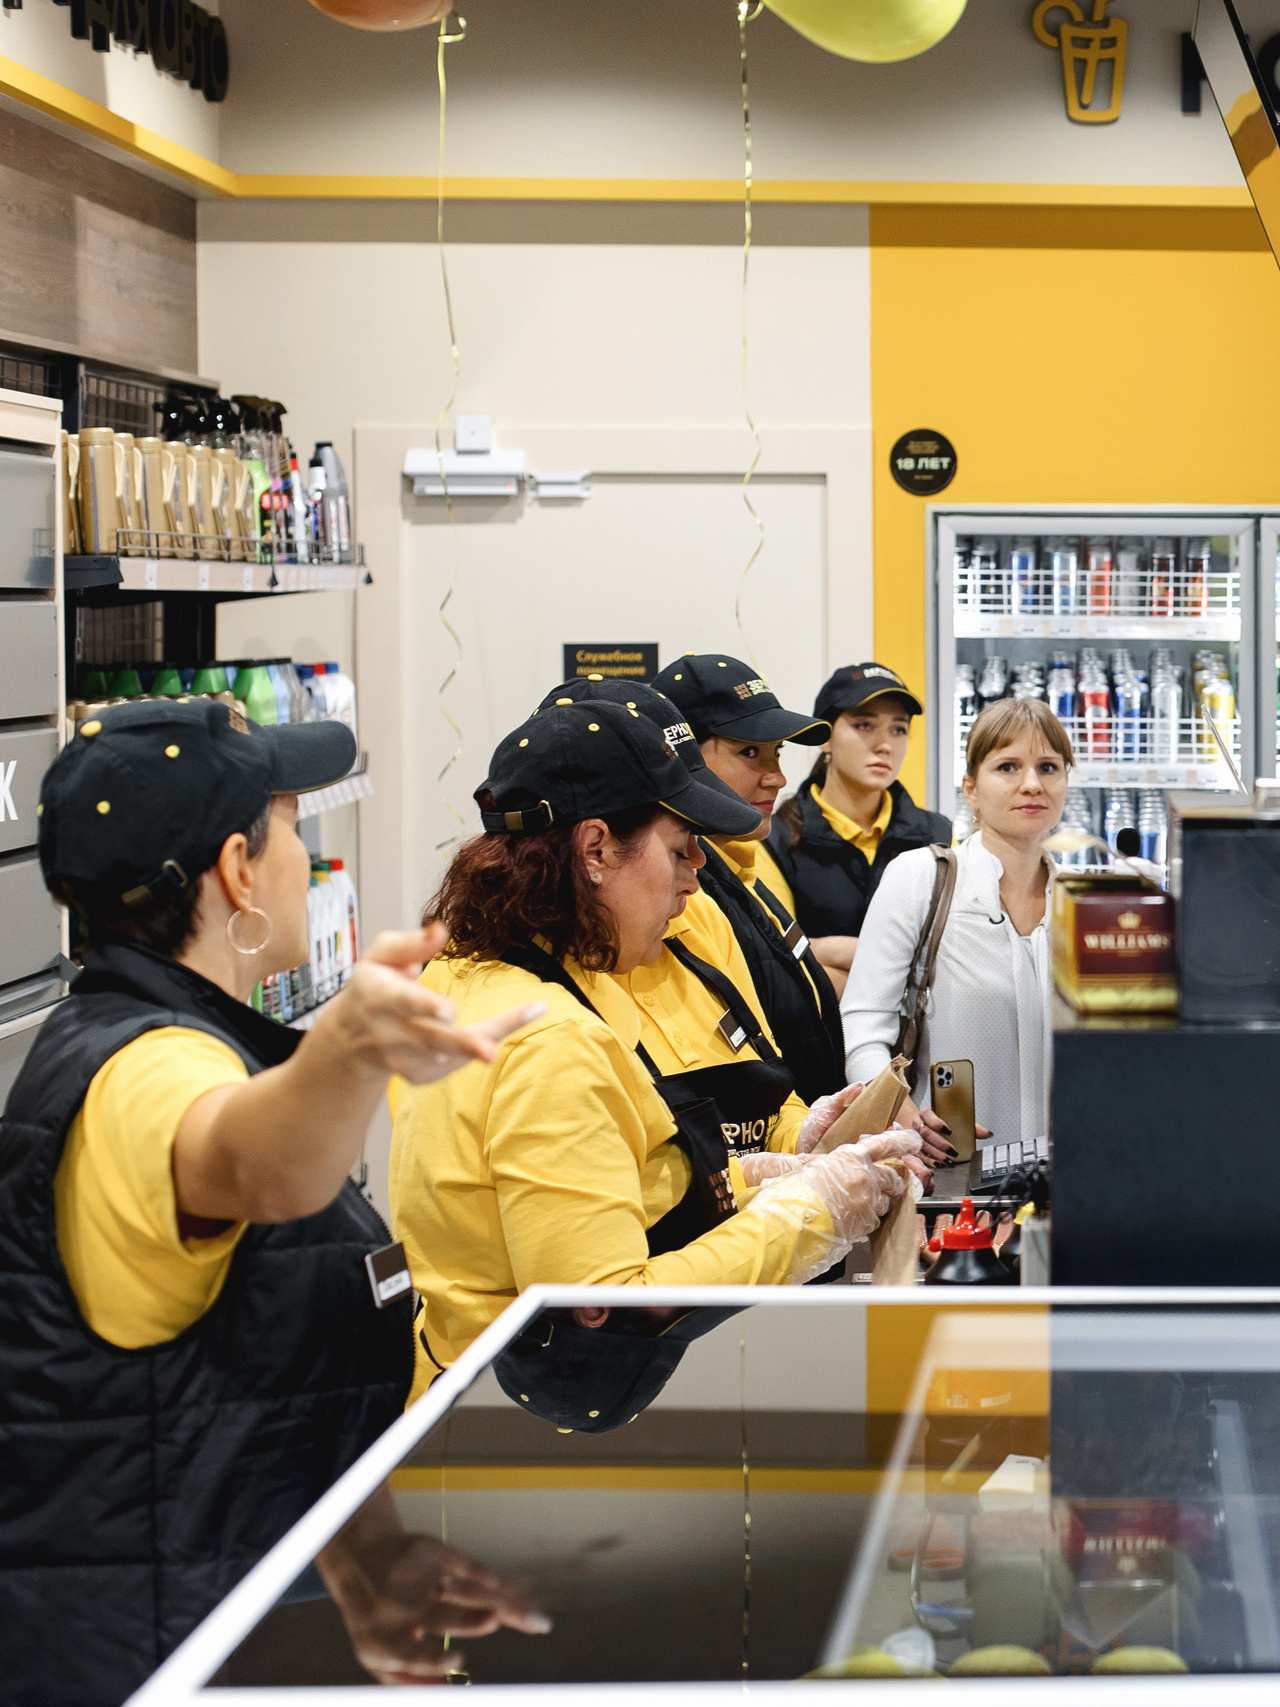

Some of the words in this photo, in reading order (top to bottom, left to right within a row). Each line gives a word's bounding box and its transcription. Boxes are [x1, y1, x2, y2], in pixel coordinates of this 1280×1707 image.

[895, 456, 915, 470] 18
[917, 456, 952, 470] ЛЕТ
[576, 649, 643, 664] Служебное
[576, 666, 646, 677] помещение
